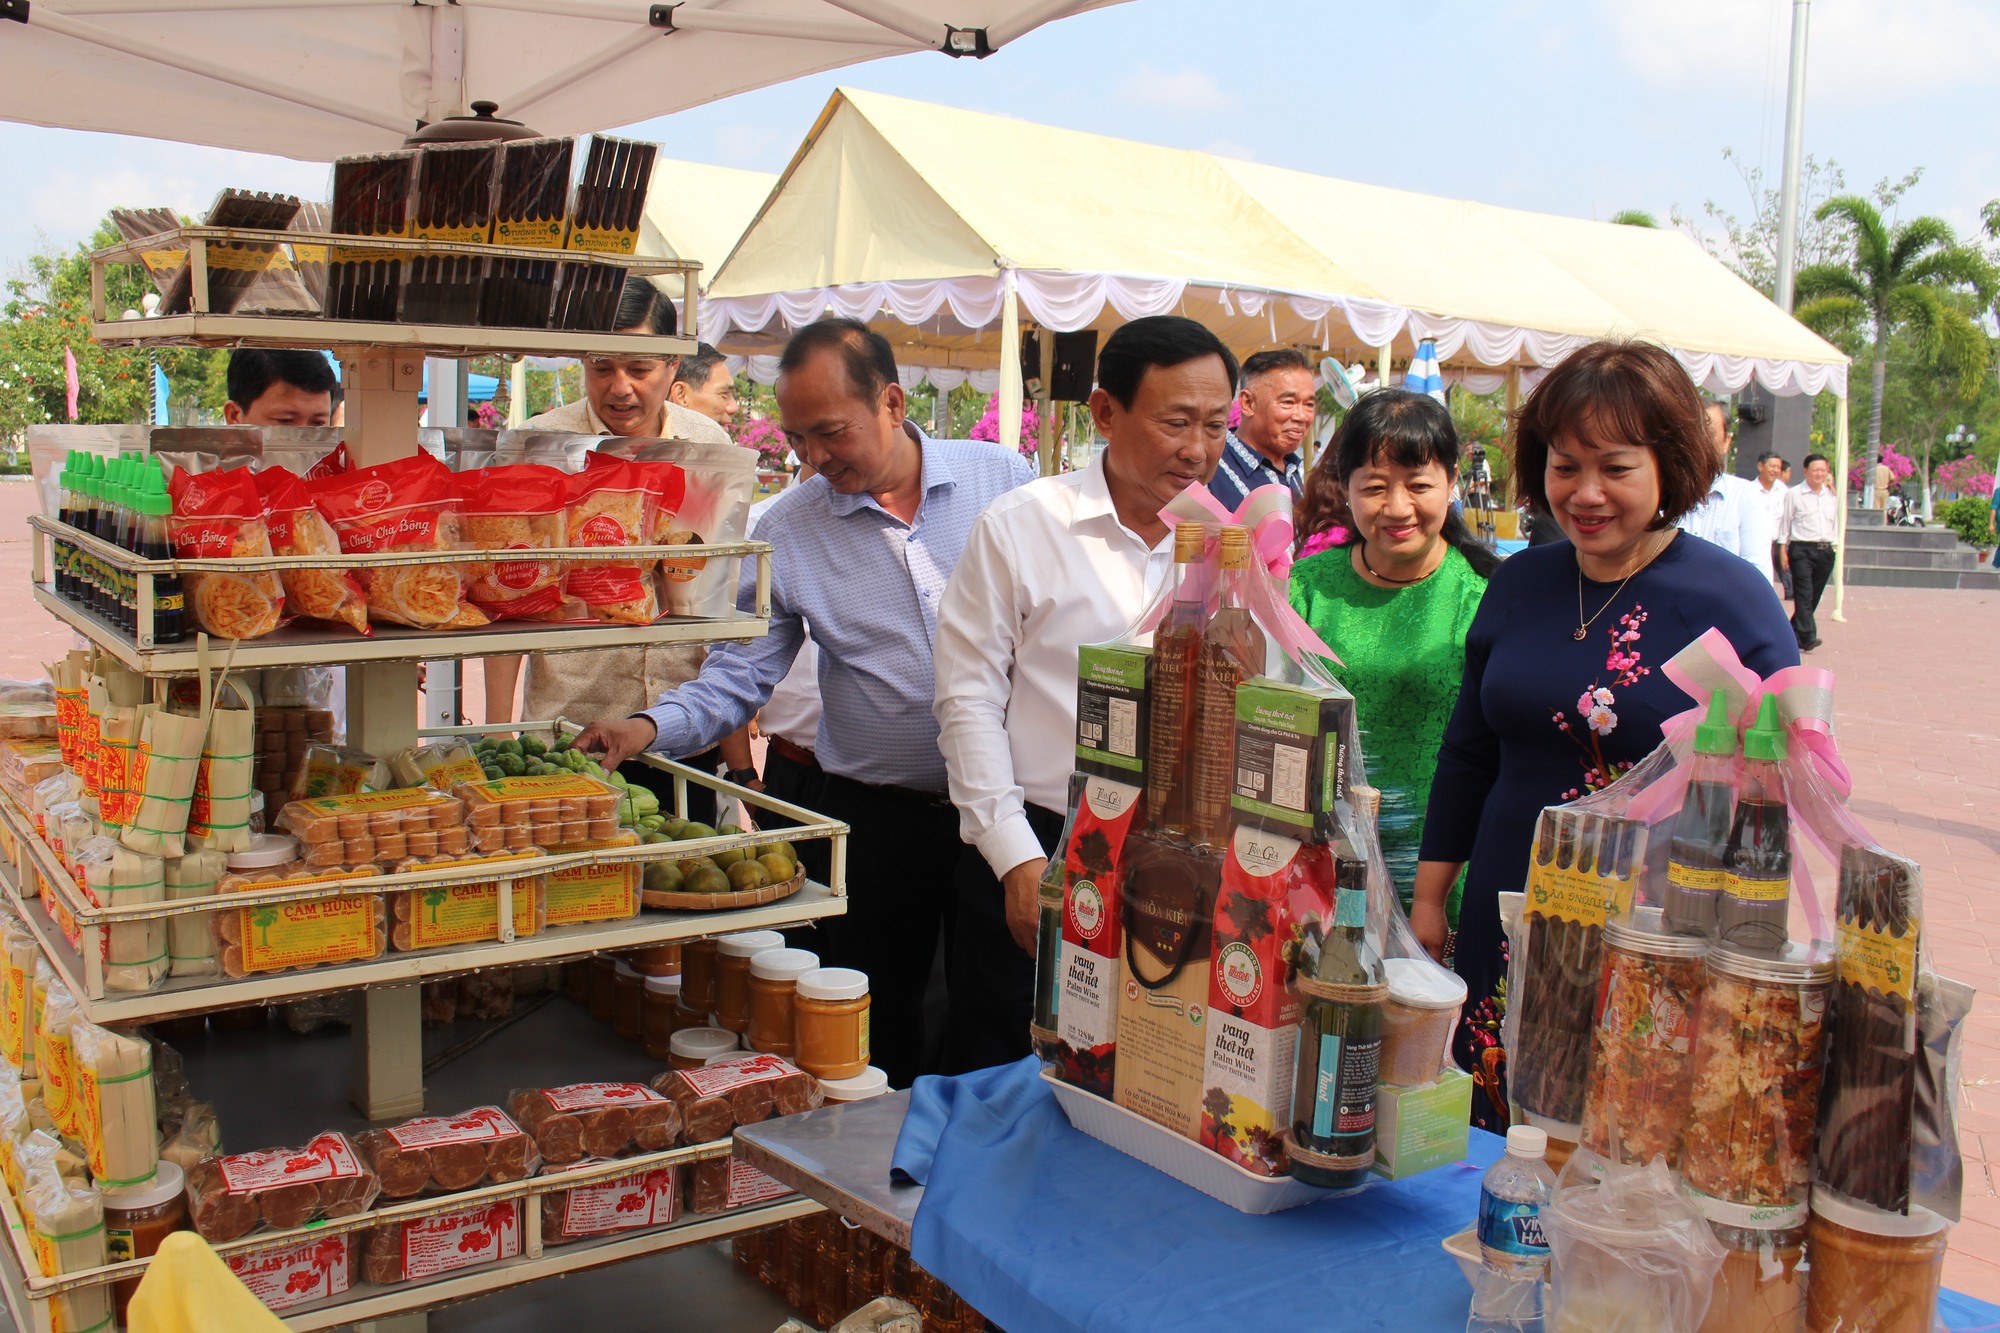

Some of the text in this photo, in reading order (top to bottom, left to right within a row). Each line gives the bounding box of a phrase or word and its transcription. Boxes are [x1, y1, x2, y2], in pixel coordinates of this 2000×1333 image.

[538, 228, 550, 236] VY
[180, 529, 227, 548] Chà Bông
[350, 519, 430, 549] Cháy Chà Bông
[1549, 888, 1602, 909] TƯỜNG VY
[1551, 901, 1565, 911] Nốt
[1565, 904, 1580, 914] Thốt
[1074, 954, 1095, 975] vang
[1854, 951, 1885, 969] TƯỜNG
[1067, 980, 1100, 1001] Palm Wine
[1222, 1023, 1250, 1046] vang
[1213, 1050, 1256, 1075] Palm Wine
[1243, 1073, 1256, 1083] WINE
[1750, 1208, 1779, 1222] NGỌC
